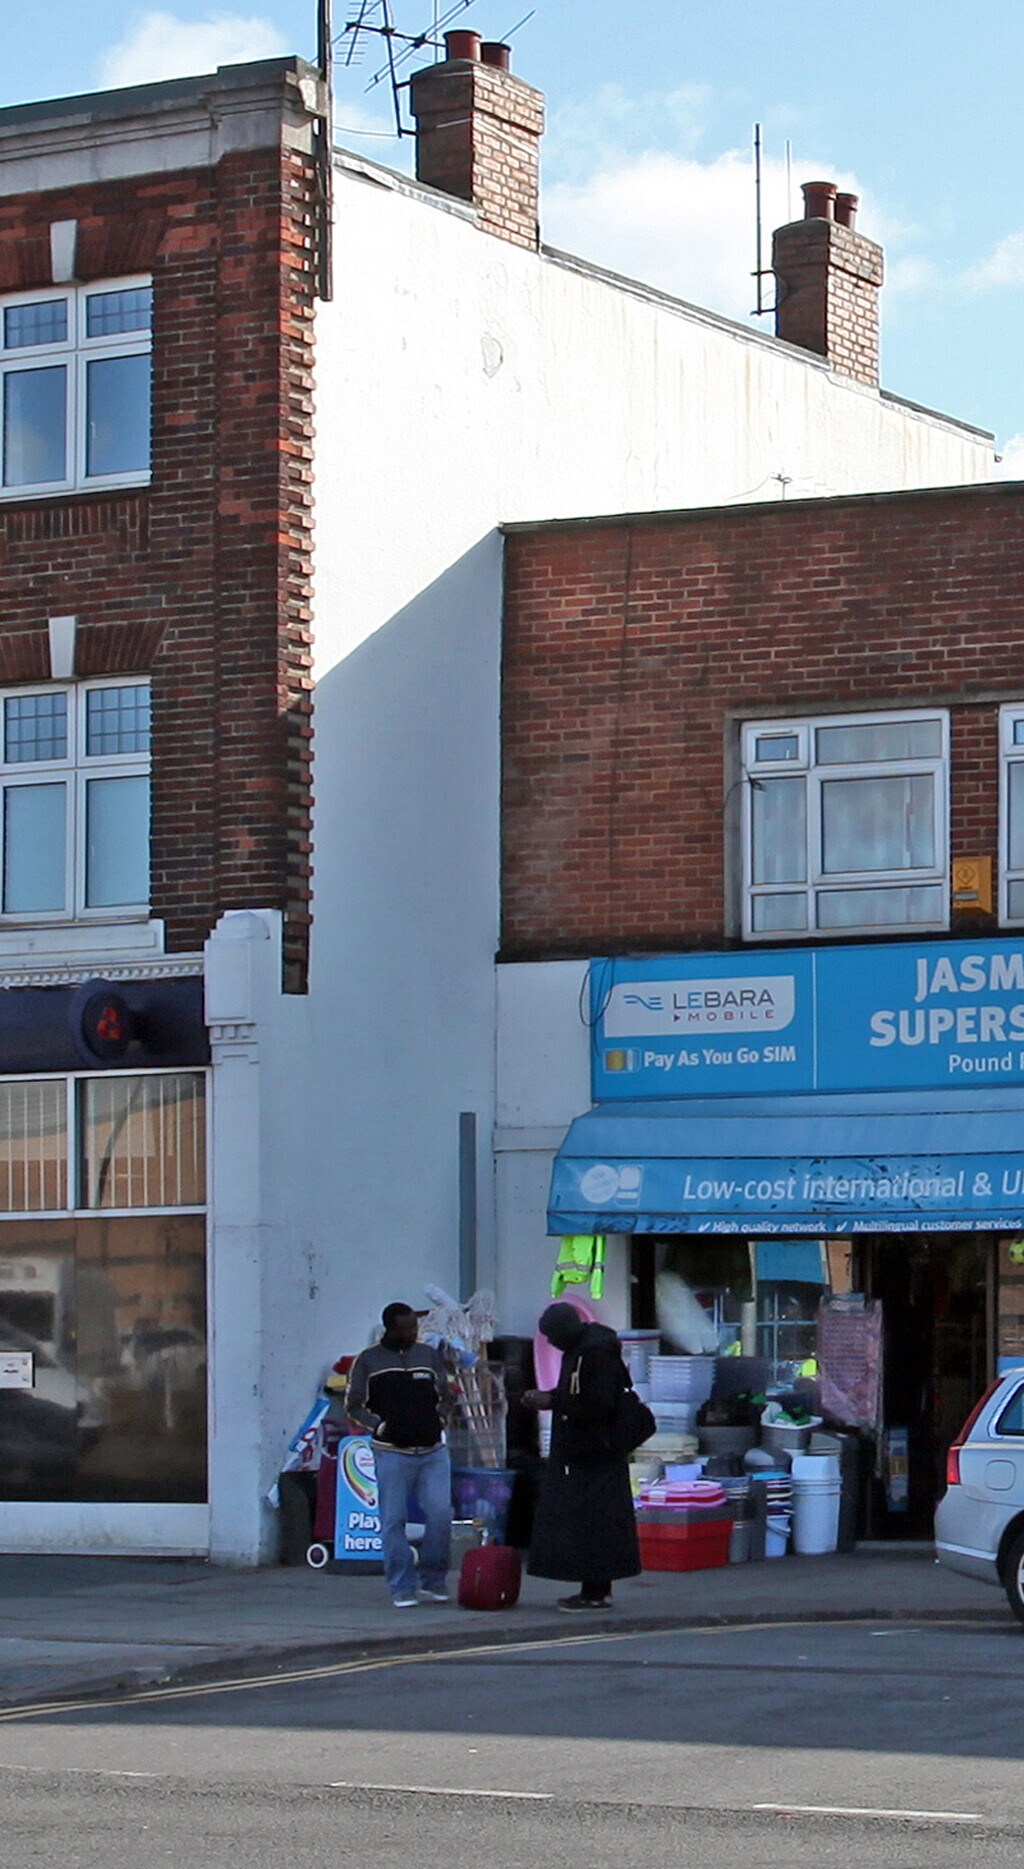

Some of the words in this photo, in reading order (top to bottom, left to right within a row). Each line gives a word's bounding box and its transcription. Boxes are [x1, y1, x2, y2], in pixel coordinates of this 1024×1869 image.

[673, 989, 775, 1010] LEBARA
[687, 1009, 775, 1022] MOBILE
[644, 1051, 674, 1071] Pay
[677, 1050, 699, 1066] As
[703, 1049, 733, 1065] You
[737, 1048, 759, 1063] Go
[763, 1046, 796, 1062] SIM
[949, 1052, 1012, 1073] Pound
[683, 1175, 795, 1200] Low-cost
[803, 1170, 964, 1199] international
[972, 1172, 993, 1196] &
[712, 1220, 739, 1233] High
[740, 1221, 778, 1234] quality
[780, 1220, 827, 1232] network
[852, 1219, 919, 1232] Multilingual
[920, 1218, 973, 1231] customer
[974, 1217, 1022, 1230] services
[349, 1512, 382, 1532] Play
[344, 1533, 383, 1550] here
